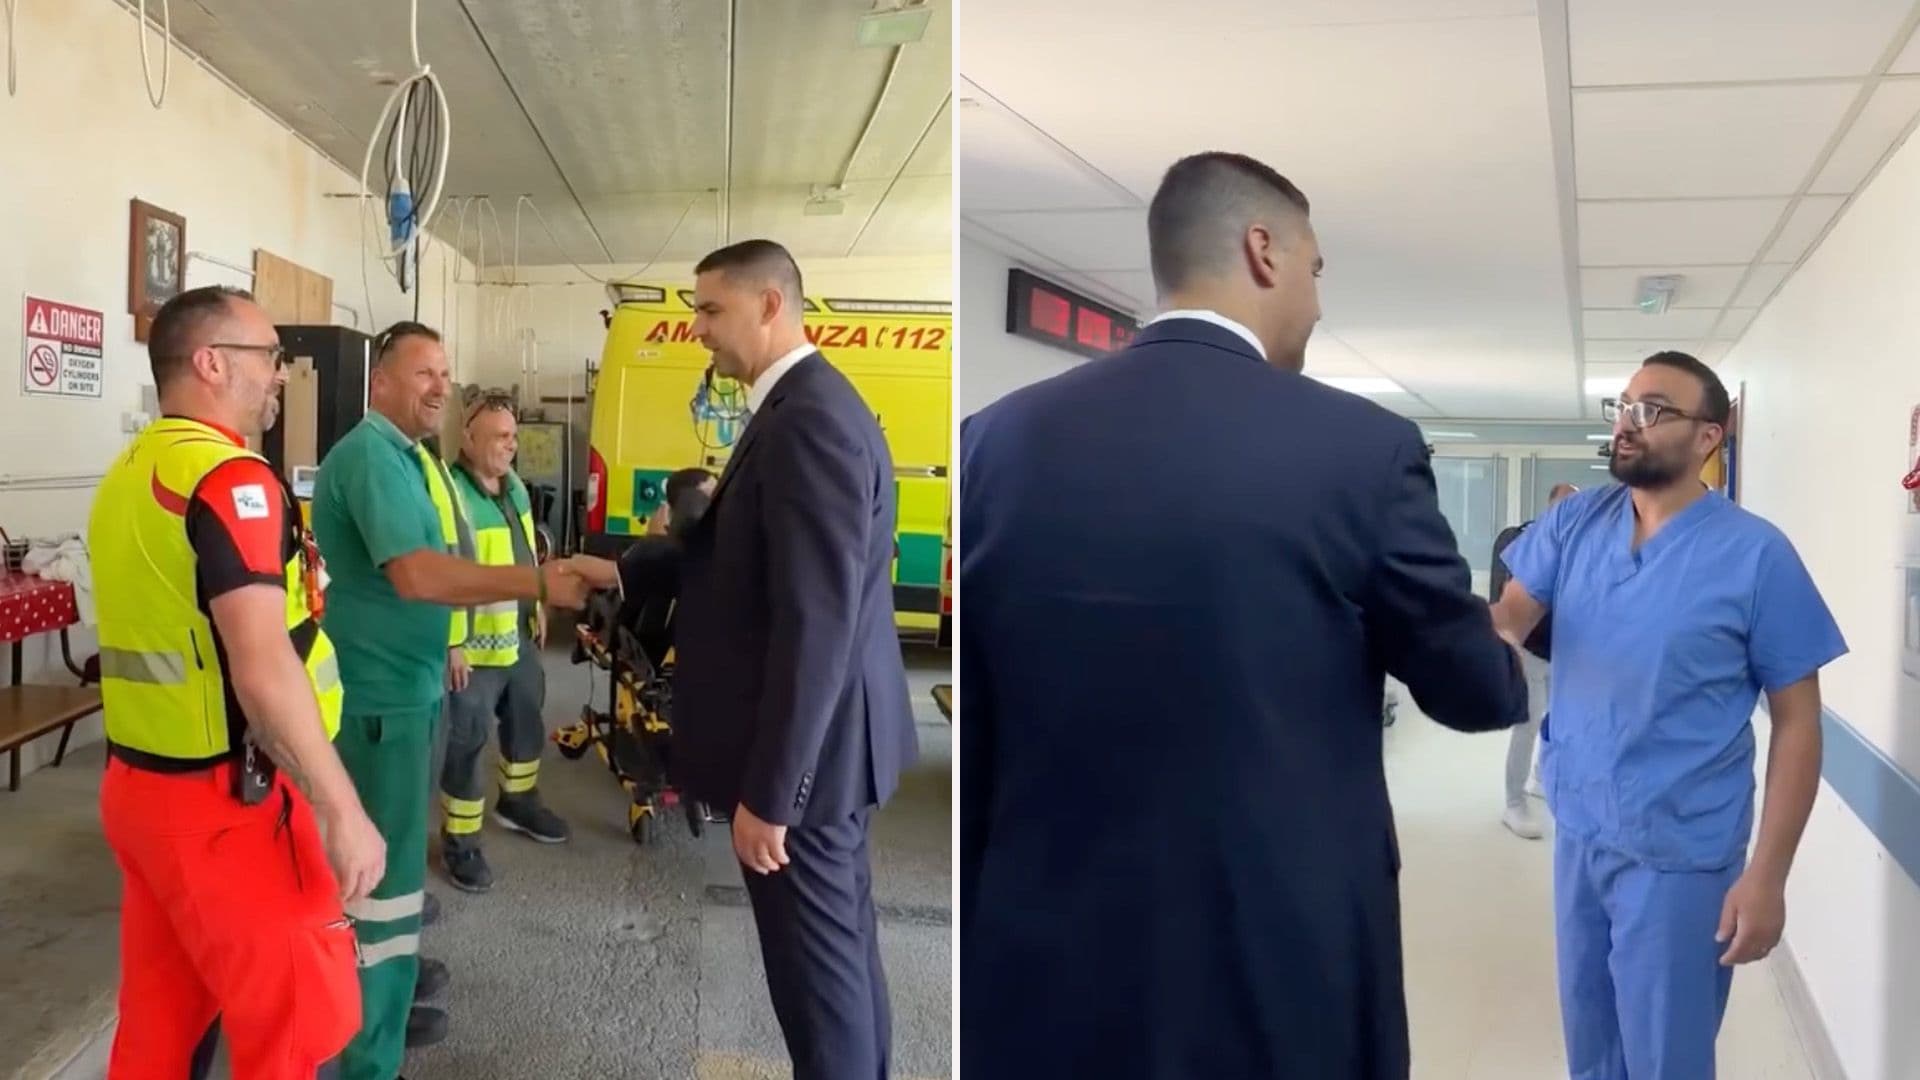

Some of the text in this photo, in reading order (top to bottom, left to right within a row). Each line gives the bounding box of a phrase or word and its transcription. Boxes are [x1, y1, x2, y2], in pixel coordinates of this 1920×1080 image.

[50, 307, 101, 342] DANGER
[644, 320, 946, 350] AMNZA 112
[69, 358, 95, 369] OXYGEN
[63, 368, 99, 381] CYLINDERS
